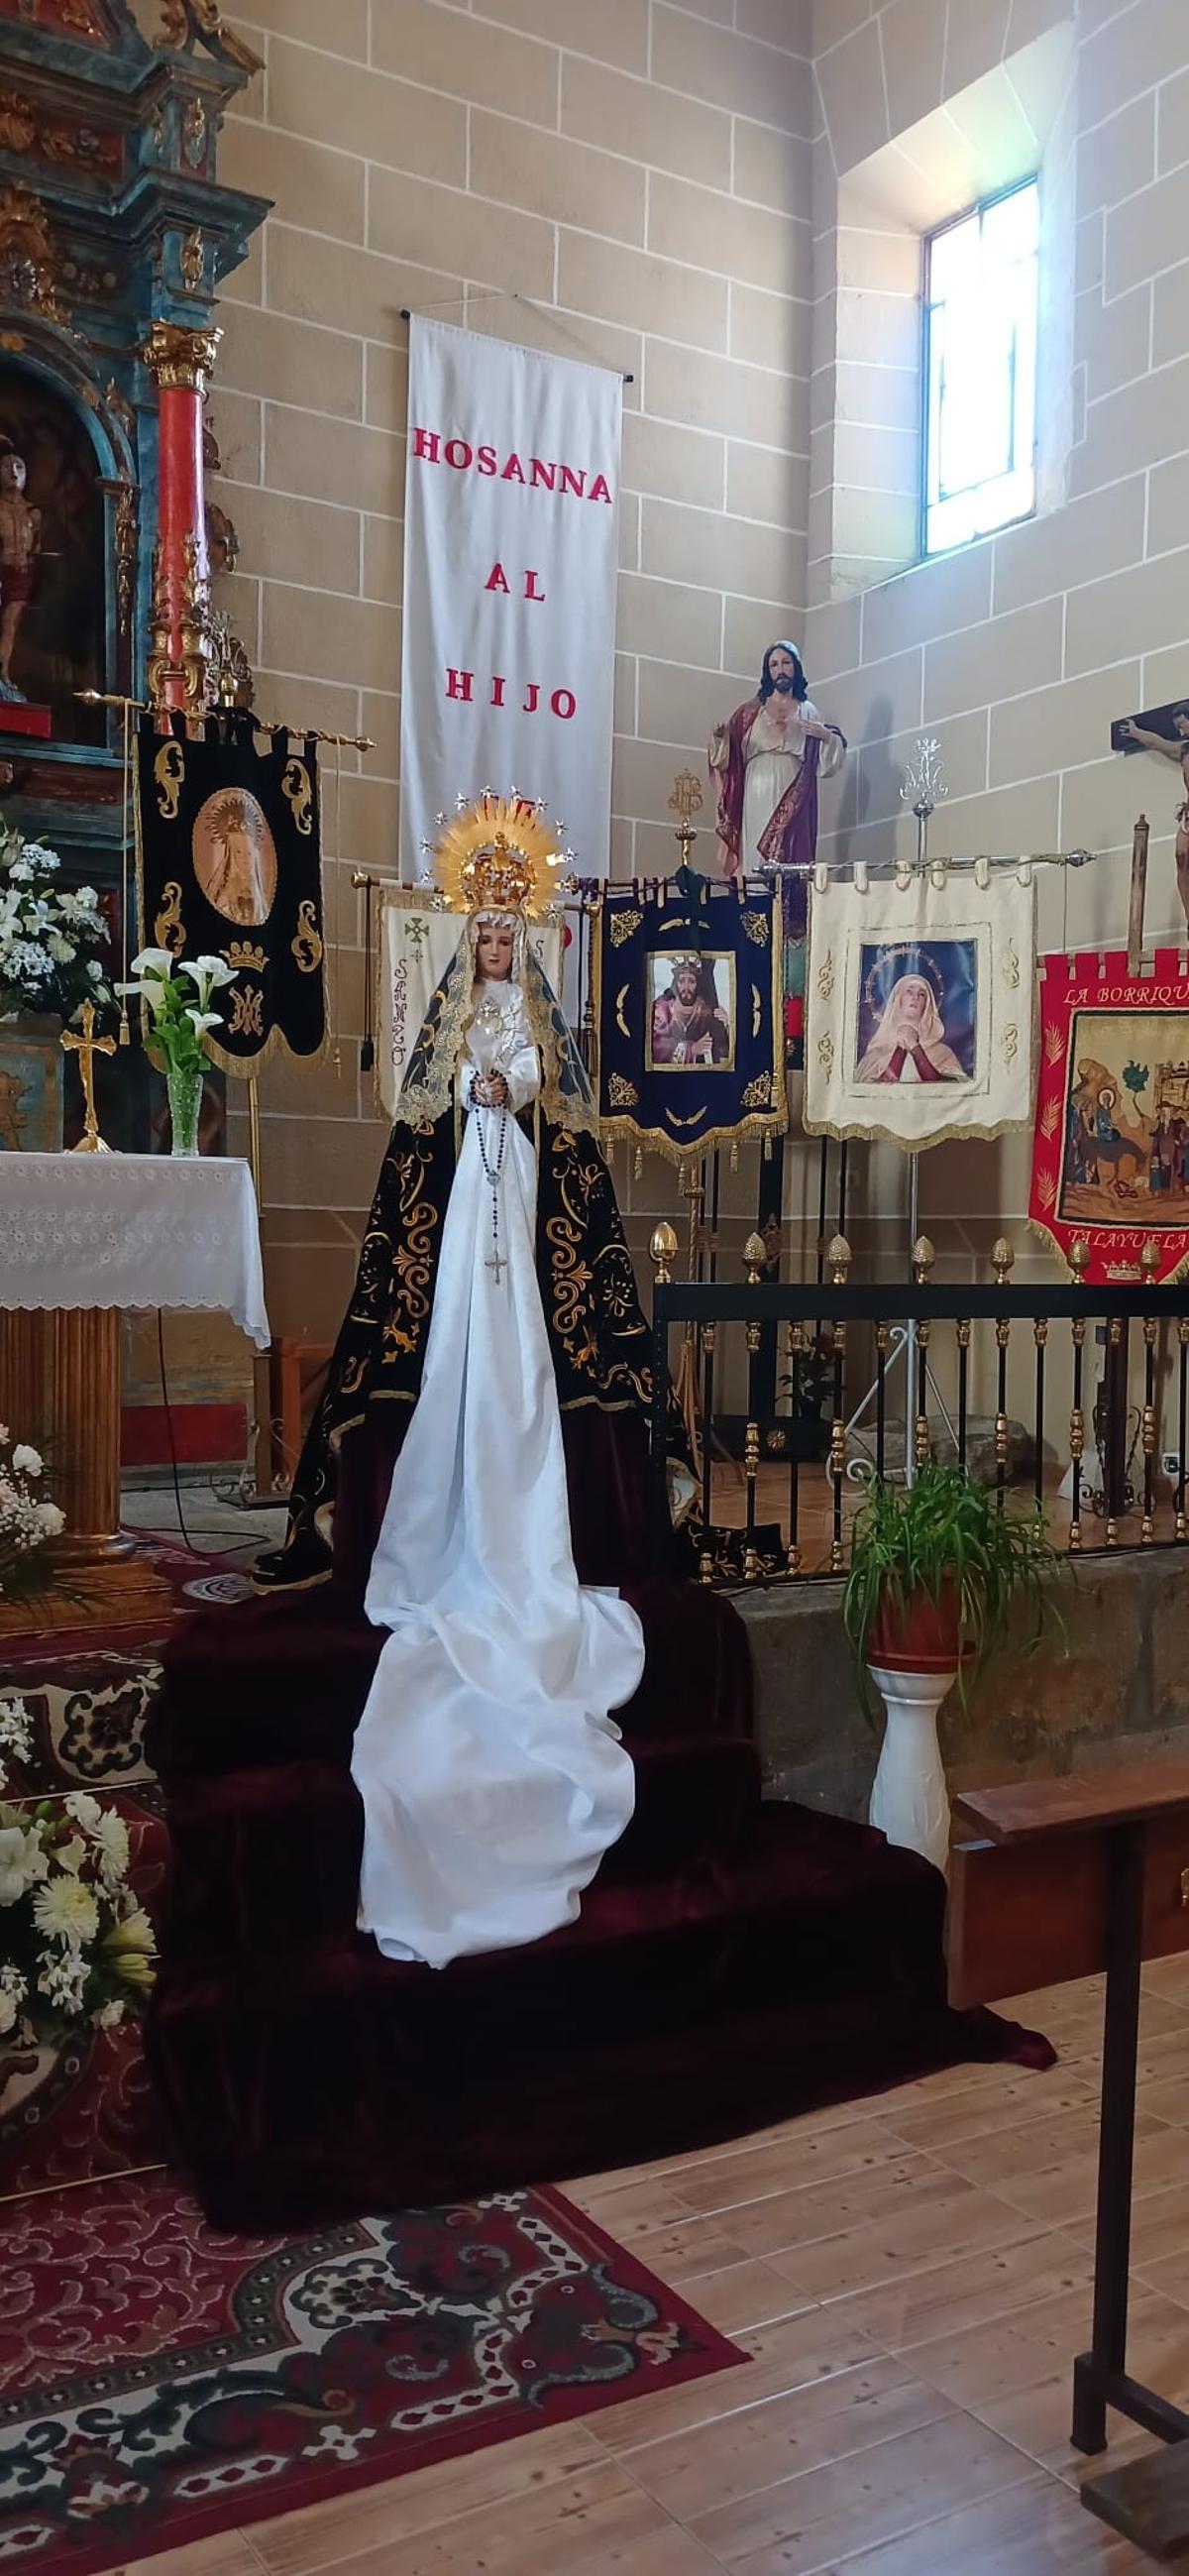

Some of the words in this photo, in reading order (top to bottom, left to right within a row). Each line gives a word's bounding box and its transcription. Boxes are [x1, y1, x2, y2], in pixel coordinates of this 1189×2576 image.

[412, 427, 613, 504] HOSANNA
[484, 562, 546, 602] AL
[445, 668, 577, 720] HIJO
[1063, 987, 1089, 1006] LA
